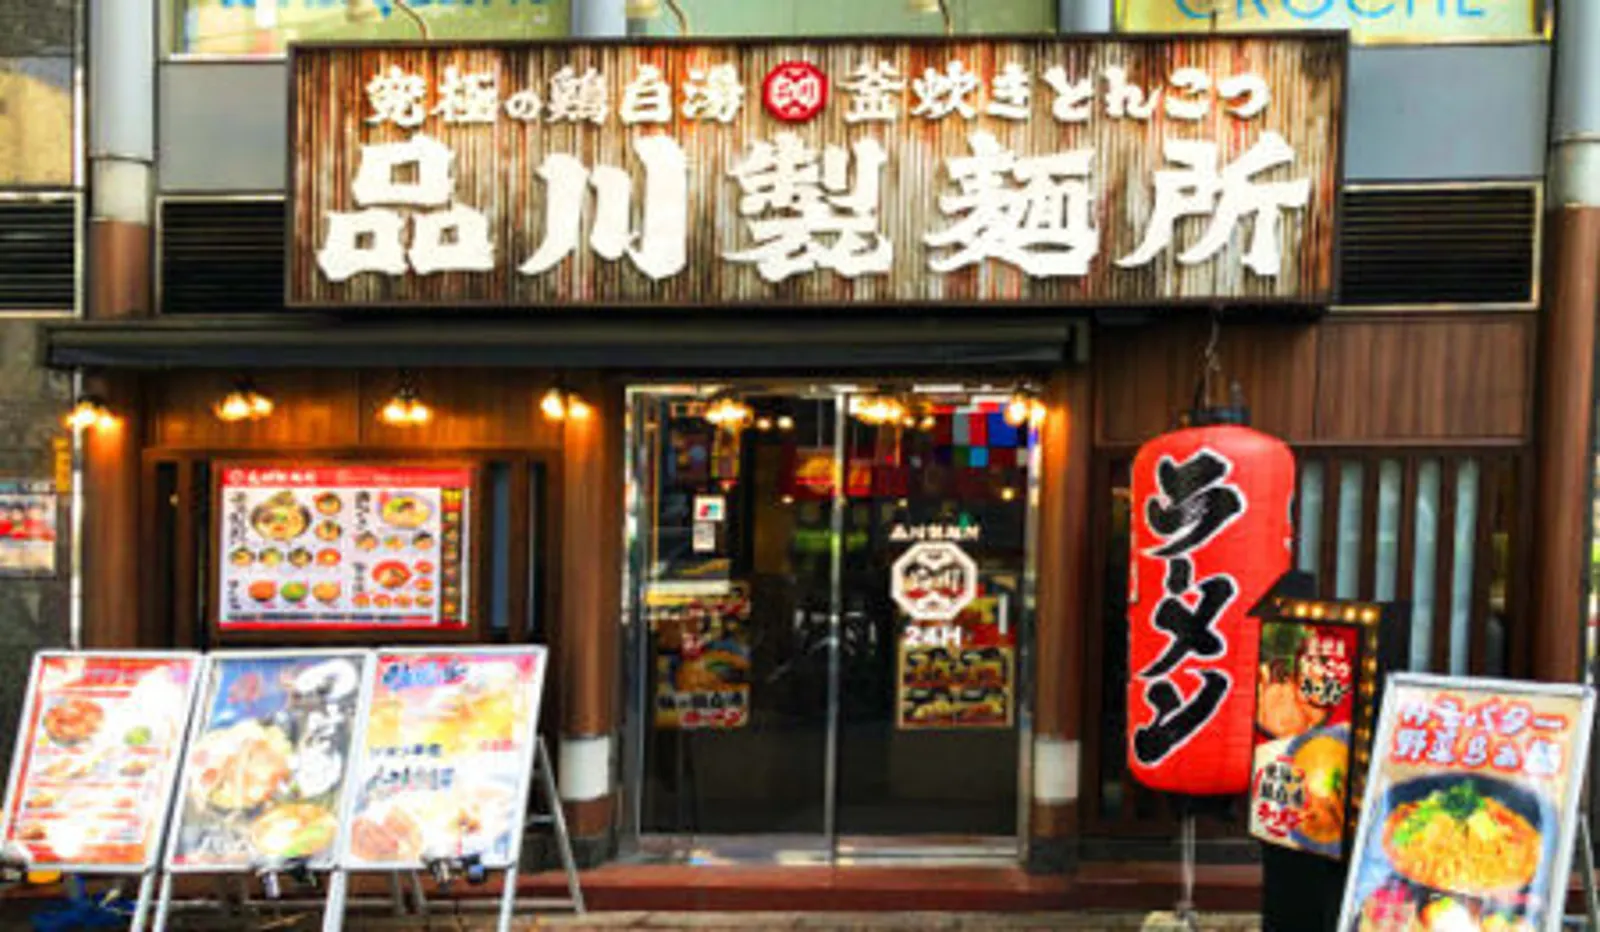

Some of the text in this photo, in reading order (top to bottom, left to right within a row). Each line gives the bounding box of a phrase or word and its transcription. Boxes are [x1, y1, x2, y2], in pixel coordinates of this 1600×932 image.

[364, 65, 744, 126] 究極の鶏白湯
[843, 61, 1272, 124] 釜炊きとんこつ
[316, 131, 1310, 284] 品川製麺所
[904, 626, 963, 647] 24H
[1134, 447, 1248, 768] ラーメン
